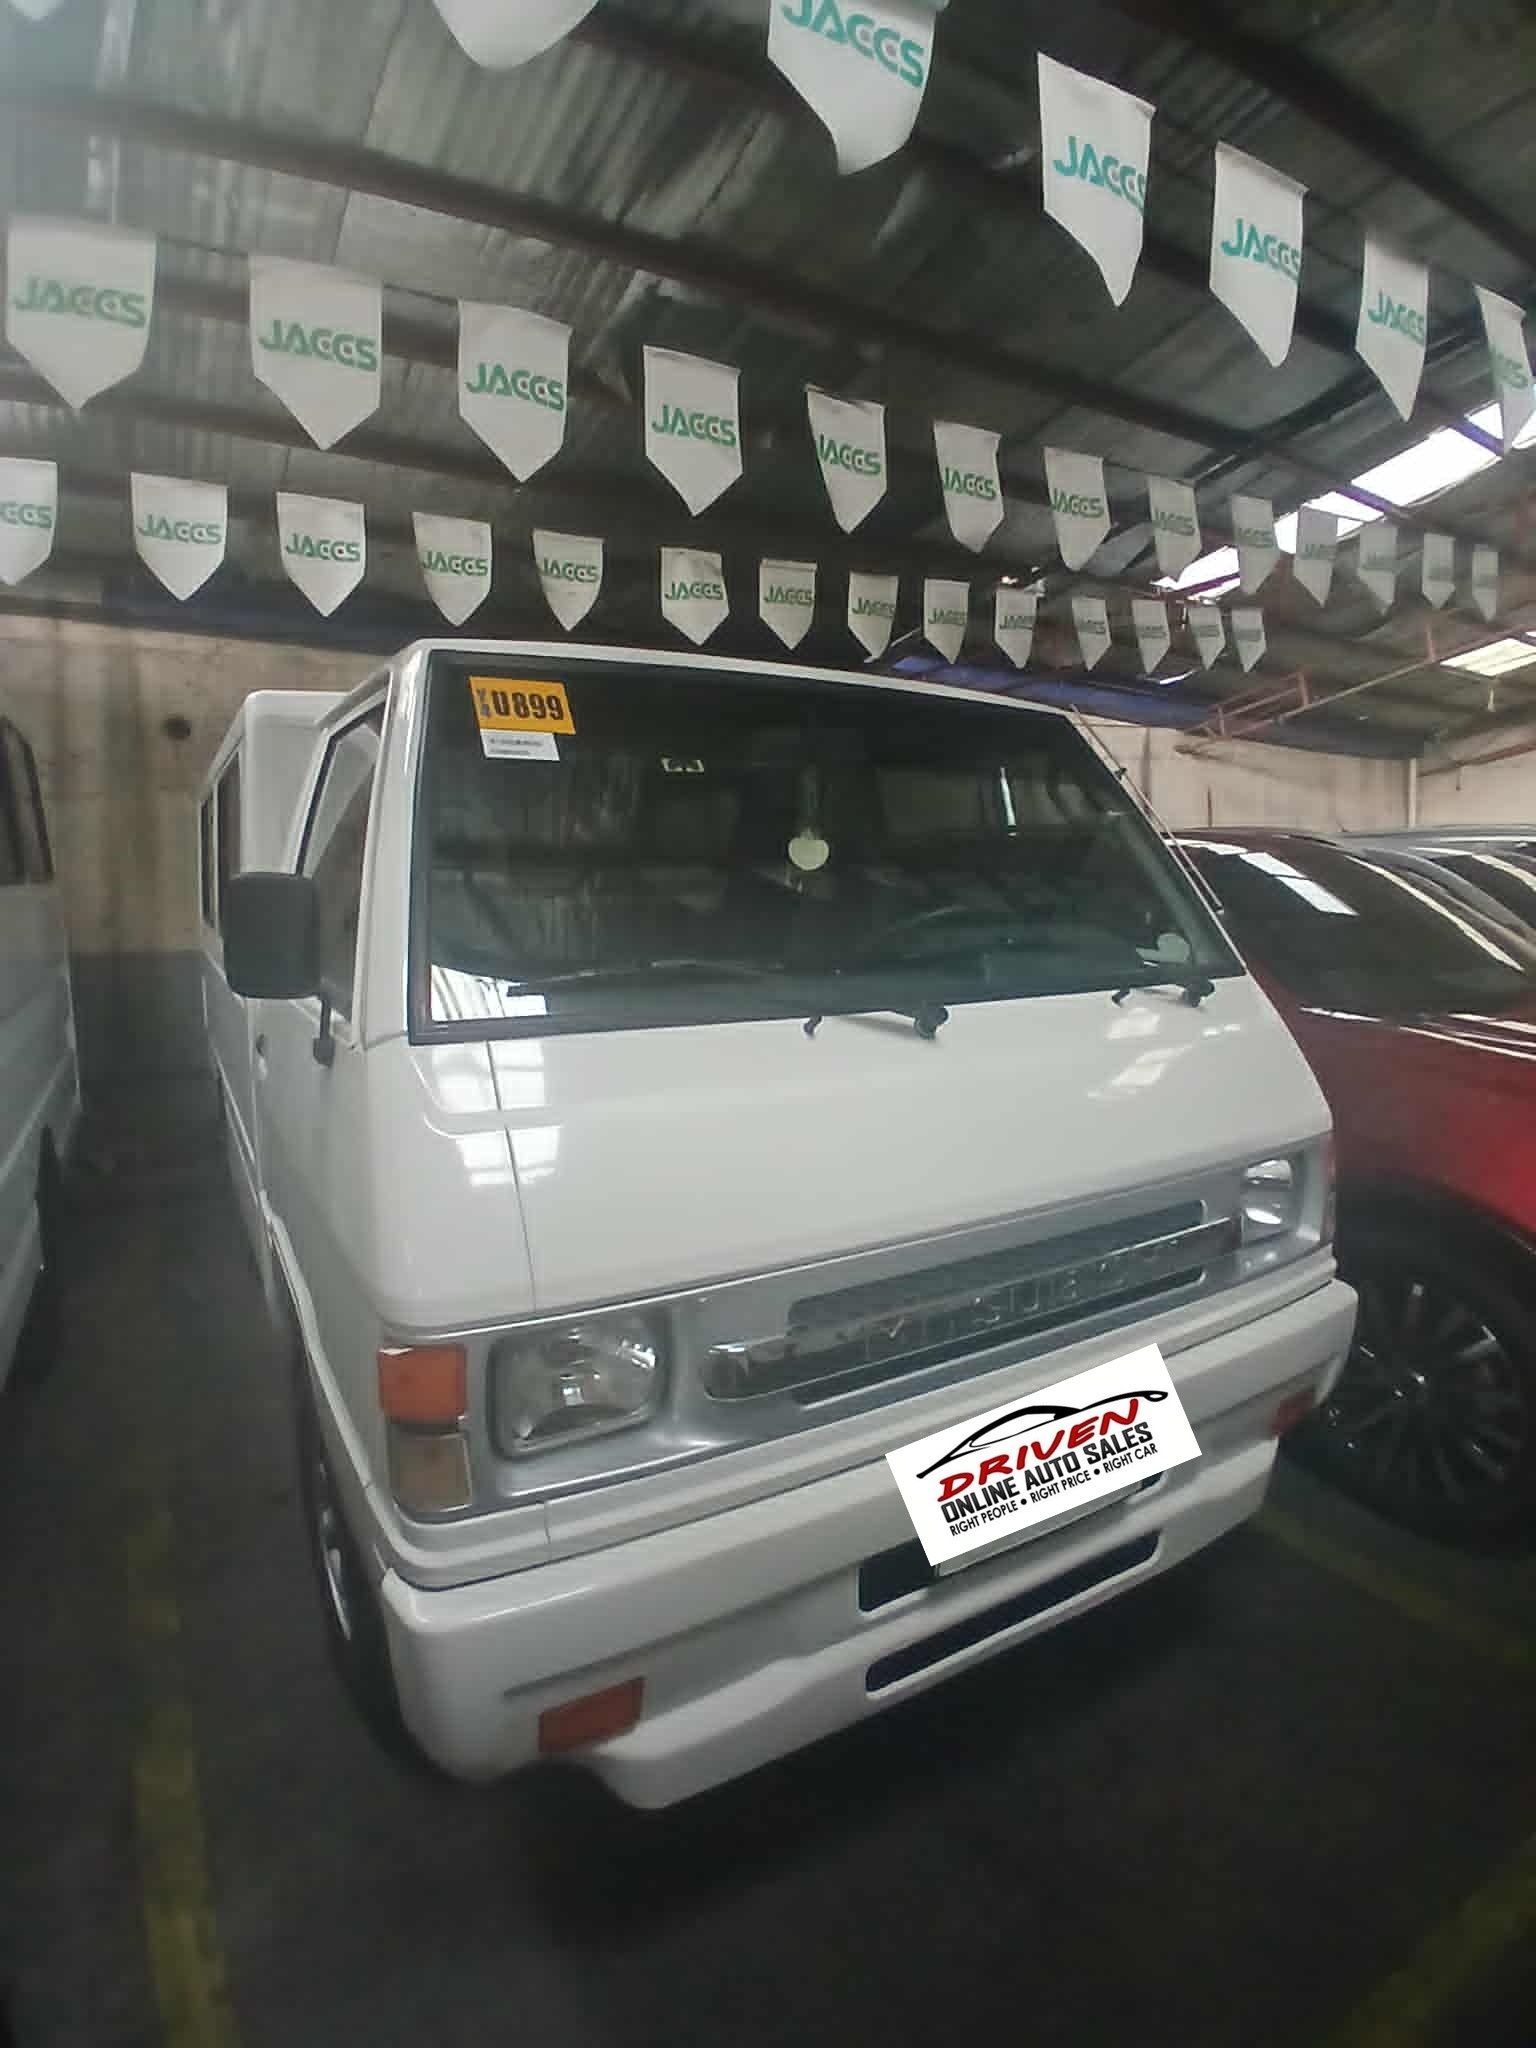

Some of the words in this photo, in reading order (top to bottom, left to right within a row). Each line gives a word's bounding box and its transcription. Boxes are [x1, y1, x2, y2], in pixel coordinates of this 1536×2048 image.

[782, 0, 925, 87] JACCS
[15, 276, 147, 329] JACCS
[259, 319, 377, 372] JACCS
[465, 361, 564, 411] JACCS
[651, 404, 737, 448] JACCS
[137, 513, 222, 544] JACCS
[285, 533, 361, 562] JACCS
[423, 550, 489, 577] JACCS
[541, 557, 598, 583] JACCS
[663, 581, 724, 602] JACCS
[764, 585, 815, 606] JACCS
